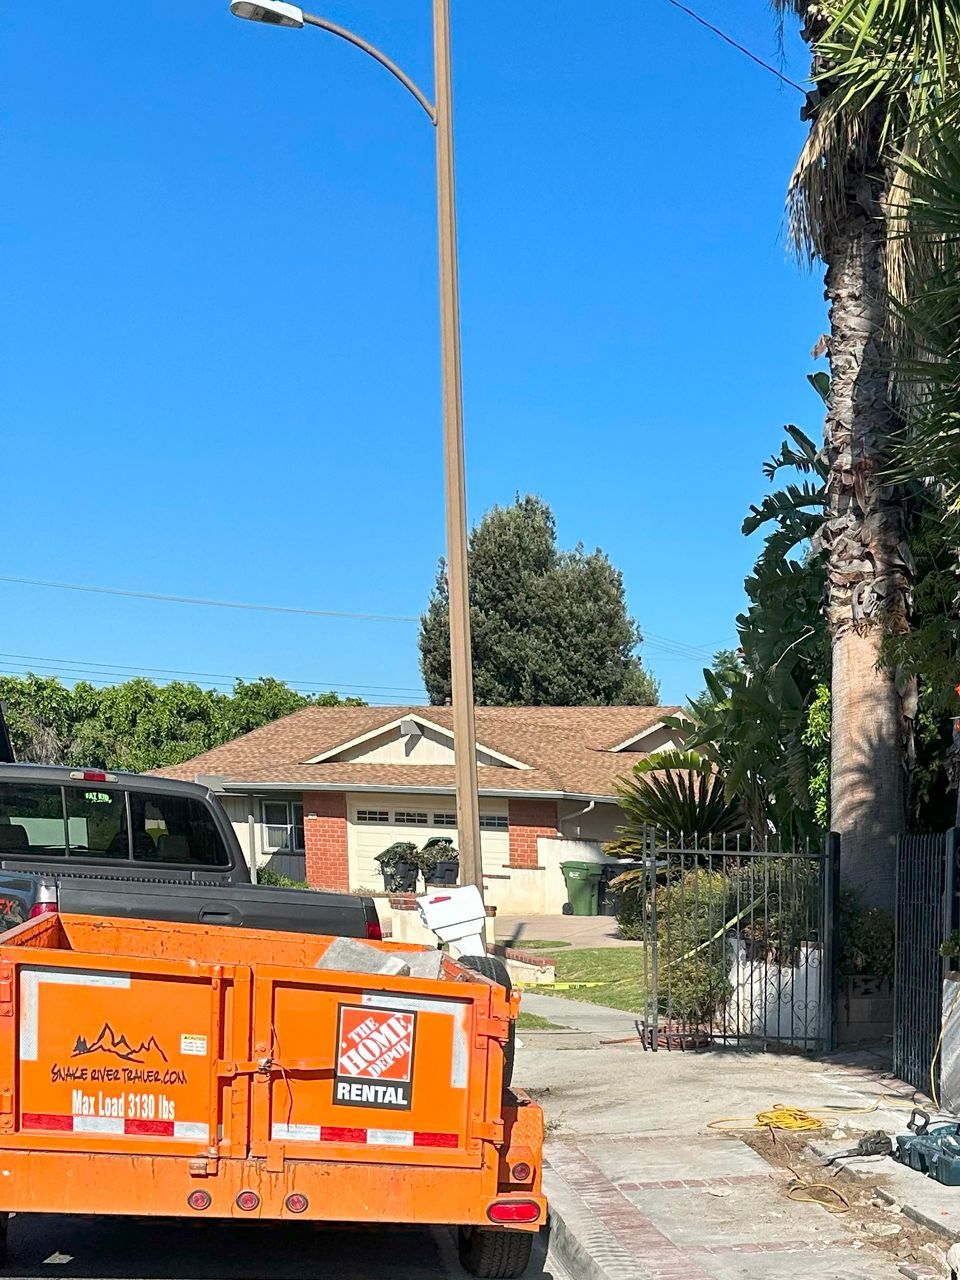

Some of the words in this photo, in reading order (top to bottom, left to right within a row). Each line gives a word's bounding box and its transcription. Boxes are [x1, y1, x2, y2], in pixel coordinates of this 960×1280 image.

[339, 1012, 412, 1076] HOME
[347, 1016, 379, 1044] THE
[366, 1038, 411, 1079] DEPOT
[51, 1063, 89, 1083] SNAKE
[90, 1066, 121, 1082] RIVER
[122, 1067, 188, 1085] TRAILER.COM
[72, 1089, 96, 1116] Max
[98, 1090, 125, 1117] Load
[128, 1092, 156, 1119] 3130
[158, 1093, 176, 1120] lbs
[336, 1082, 408, 1105] RENTAL
